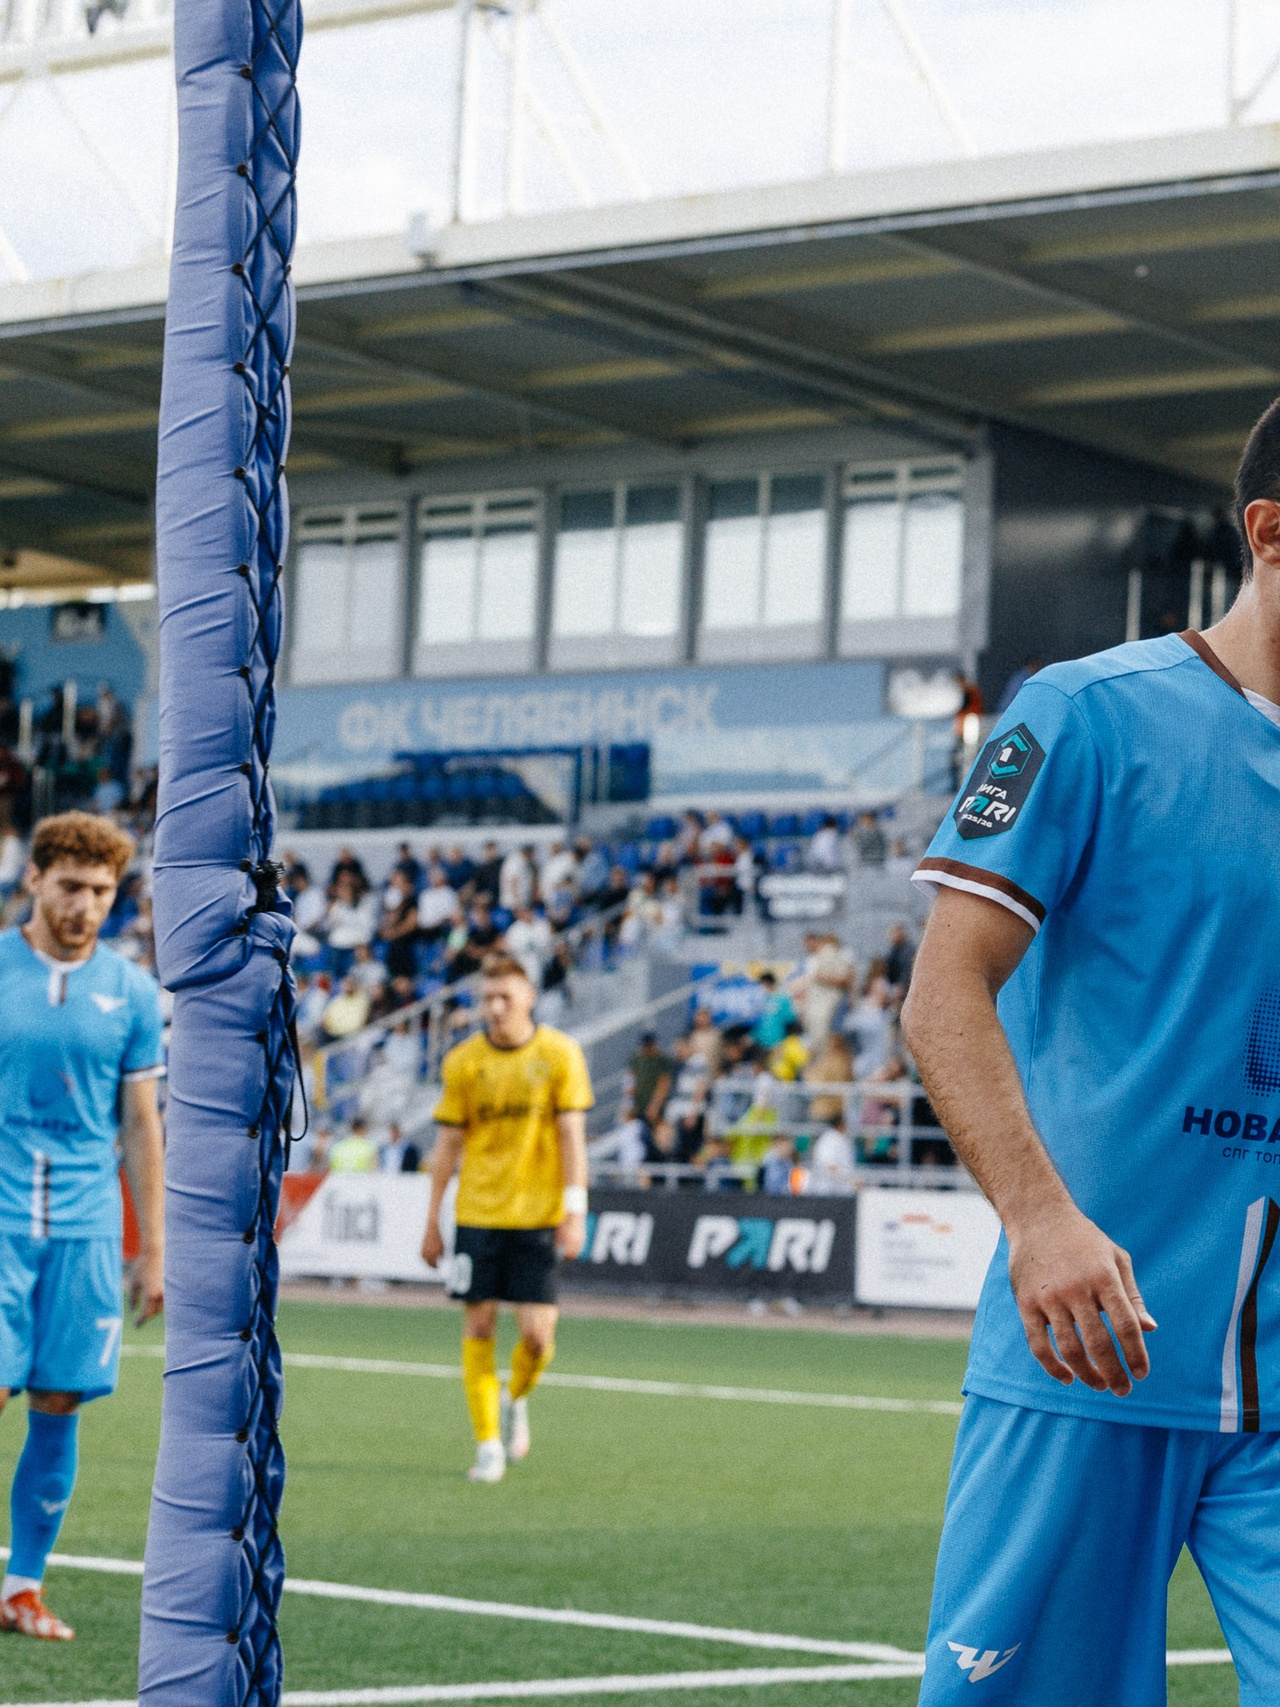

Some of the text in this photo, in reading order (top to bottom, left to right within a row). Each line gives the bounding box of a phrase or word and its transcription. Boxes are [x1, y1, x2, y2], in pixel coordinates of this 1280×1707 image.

[338, 682, 721, 751] ФК ЧЕЛЯБИНСК
[1222, 1147, 1250, 1160] СПГ
[686, 1214, 837, 1274] PARI
[95, 1317, 122, 1367] 7
